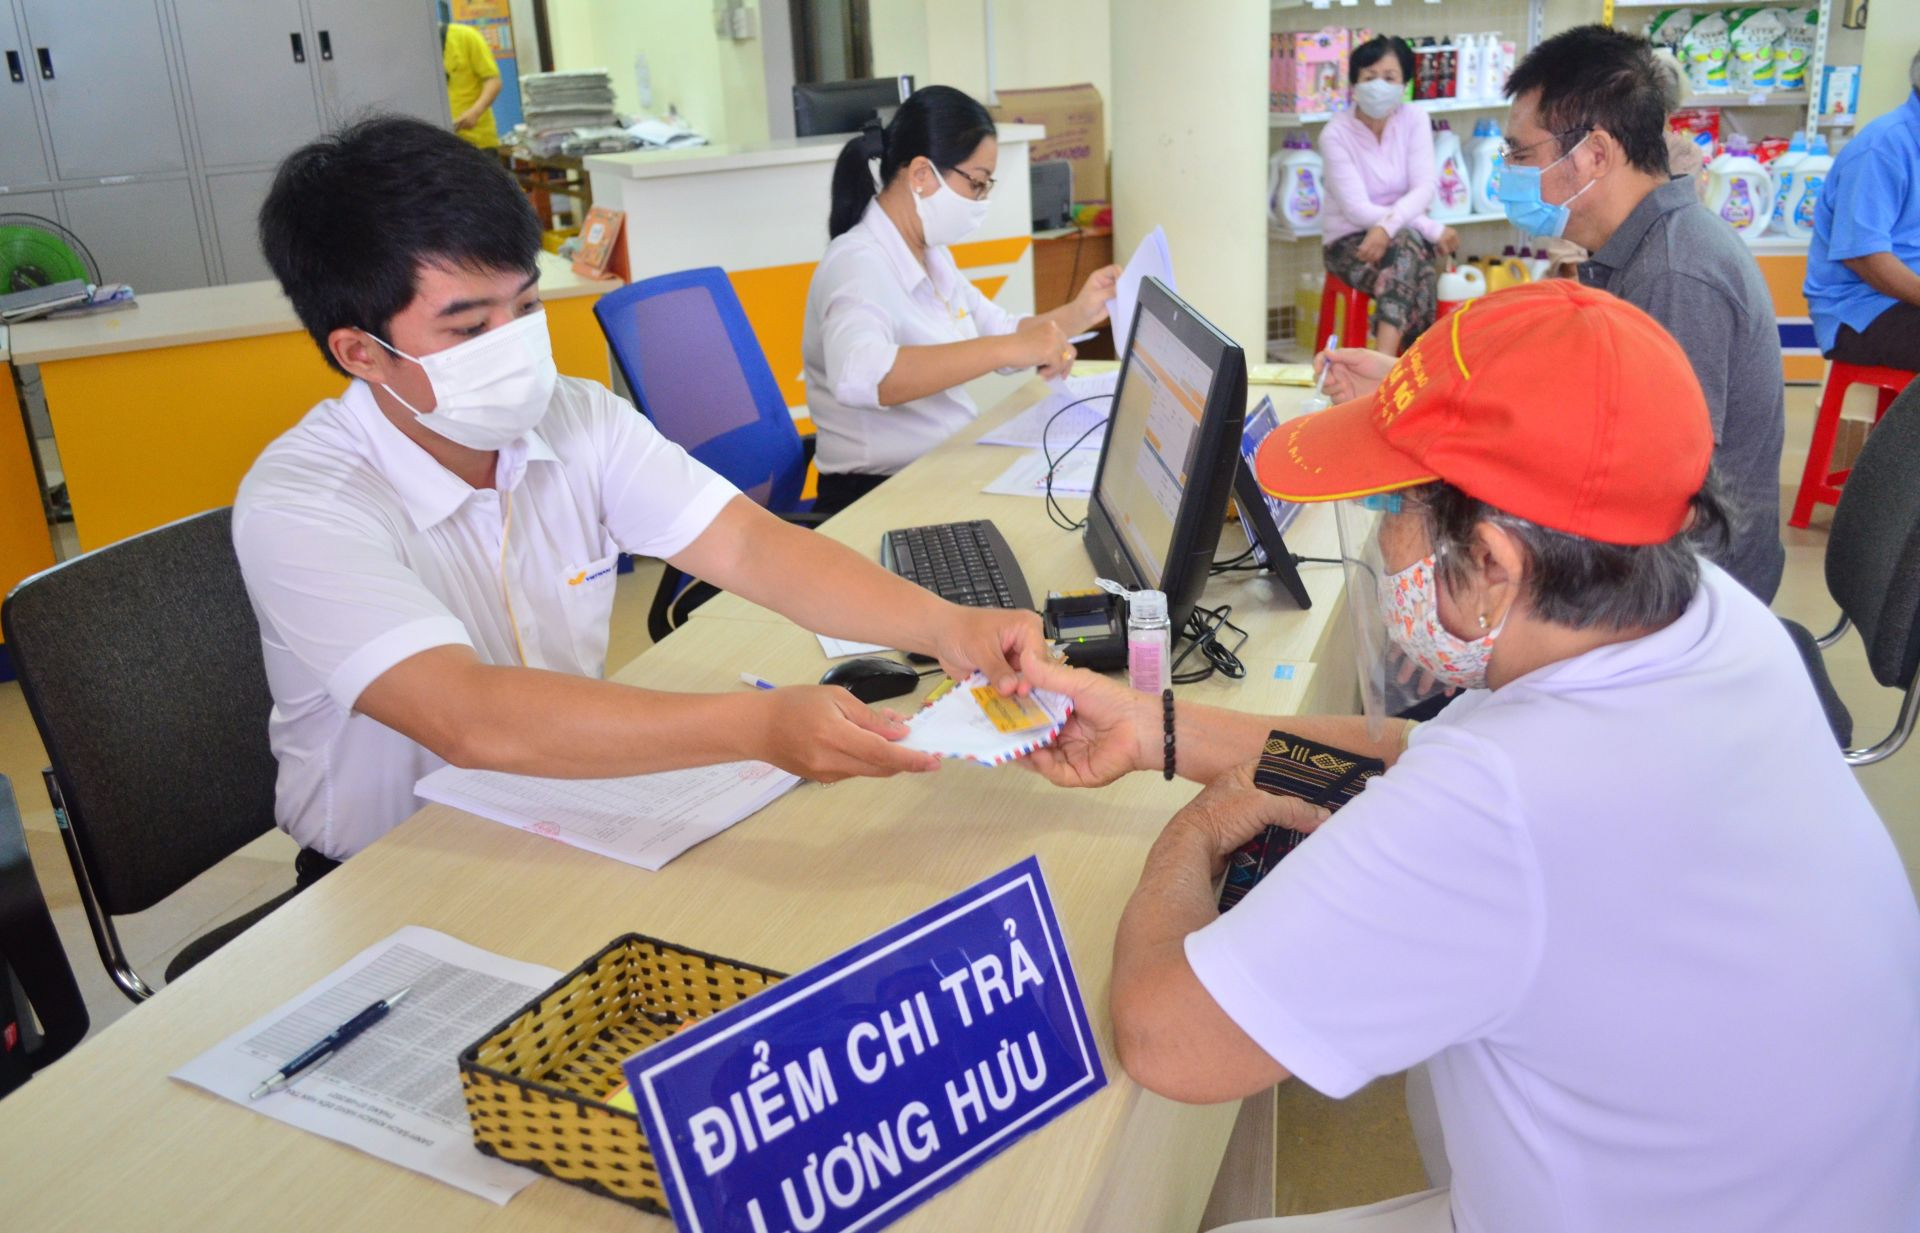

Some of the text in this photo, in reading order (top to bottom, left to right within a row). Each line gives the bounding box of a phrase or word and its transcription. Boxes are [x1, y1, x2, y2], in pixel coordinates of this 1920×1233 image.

[688, 918, 1044, 1177] ĐIỂM CHI TRẢ
[747, 1030, 1047, 1233] LƯƠNG HƯU
